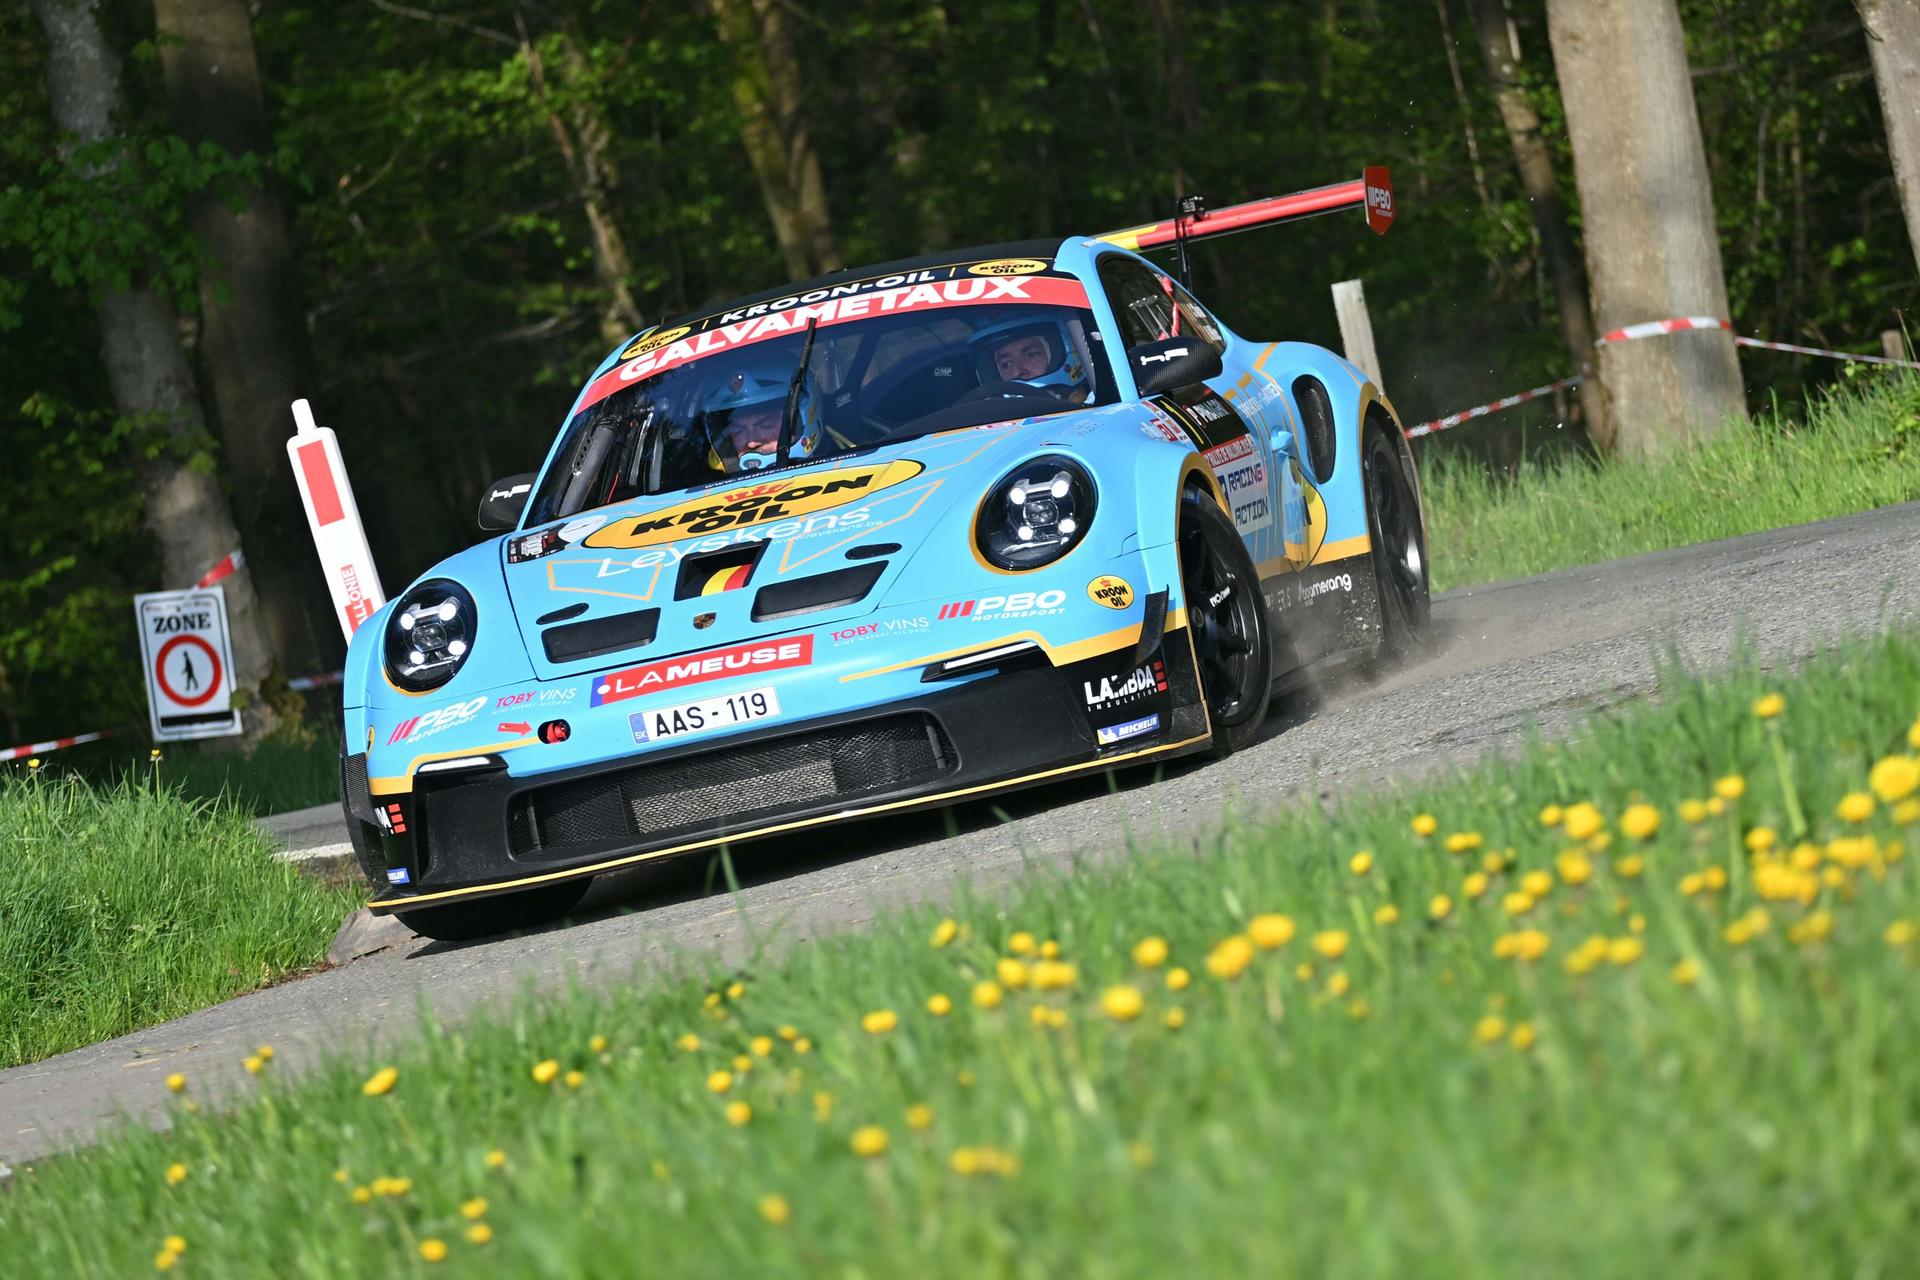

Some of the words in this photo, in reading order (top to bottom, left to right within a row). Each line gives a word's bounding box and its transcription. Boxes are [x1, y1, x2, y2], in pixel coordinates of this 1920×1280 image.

[720, 270, 935, 324] KROON-OIL
[619, 275, 1032, 381] GALVAMETAUX
[1227, 463, 1263, 493] RACING
[631, 474, 874, 536] KROON
[687, 505, 790, 533] OIL
[1234, 496, 1269, 526] ACTION
[597, 506, 870, 578] Leyskens
[975, 589, 1066, 615] PBO
[1094, 585, 1128, 600] KROON
[1110, 596, 1126, 607] OIL
[153, 611, 212, 635] ZONE
[831, 623, 879, 641] TOBY
[884, 617, 930, 630] VINS
[972, 607, 1066, 623] MOTORSPORT
[496, 691, 537, 708] TOBY
[540, 688, 577, 700] VINS
[411, 696, 489, 735] PBO
[656, 706, 705, 737] AAS
[726, 693, 767, 722] 119
[1118, 717, 1157, 736] MICHELIN
[407, 714, 478, 745] MOTORSPORT
[635, 731, 648, 740] SK
